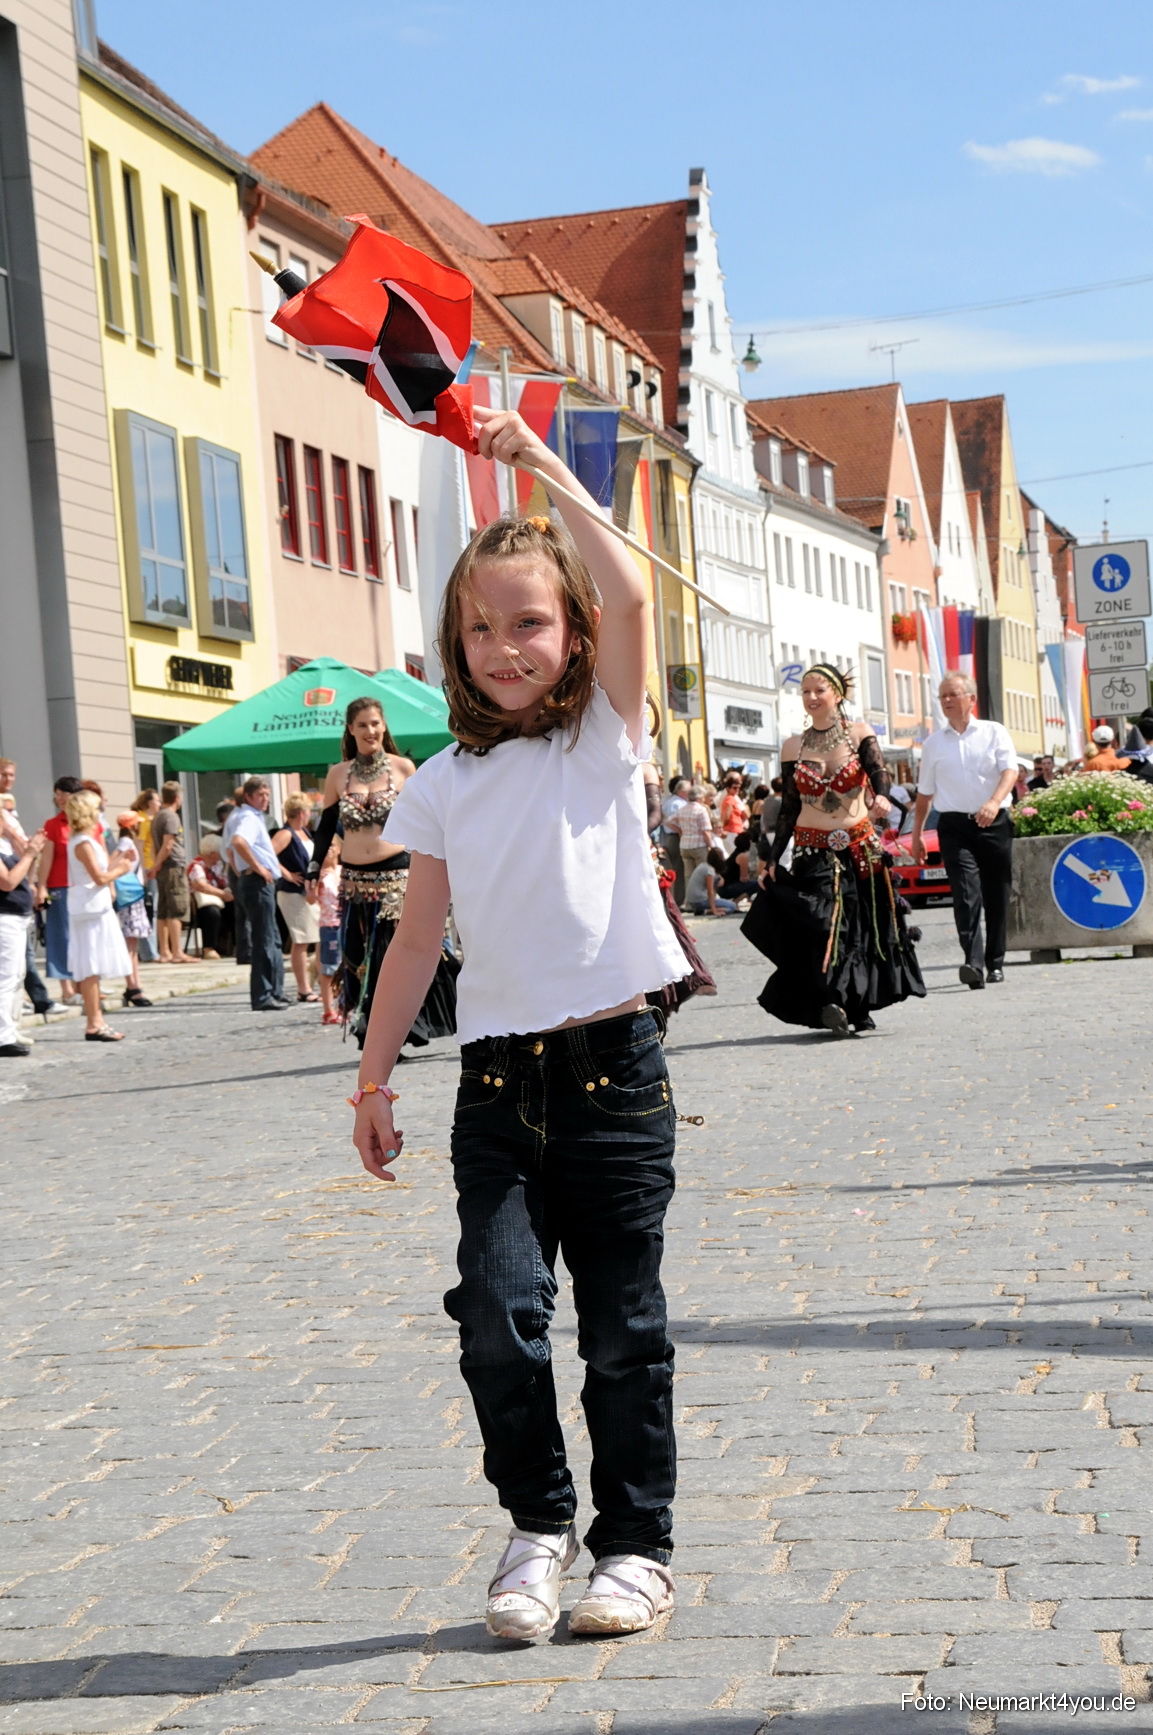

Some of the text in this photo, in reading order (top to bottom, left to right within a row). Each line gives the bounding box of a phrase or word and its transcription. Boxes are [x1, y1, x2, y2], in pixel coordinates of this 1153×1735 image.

[1095, 599, 1132, 614] ZONE
[1088, 627, 1142, 641] Lieferverkehr
[1110, 653, 1124, 663] frei
[1110, 700, 1129, 711] frei
